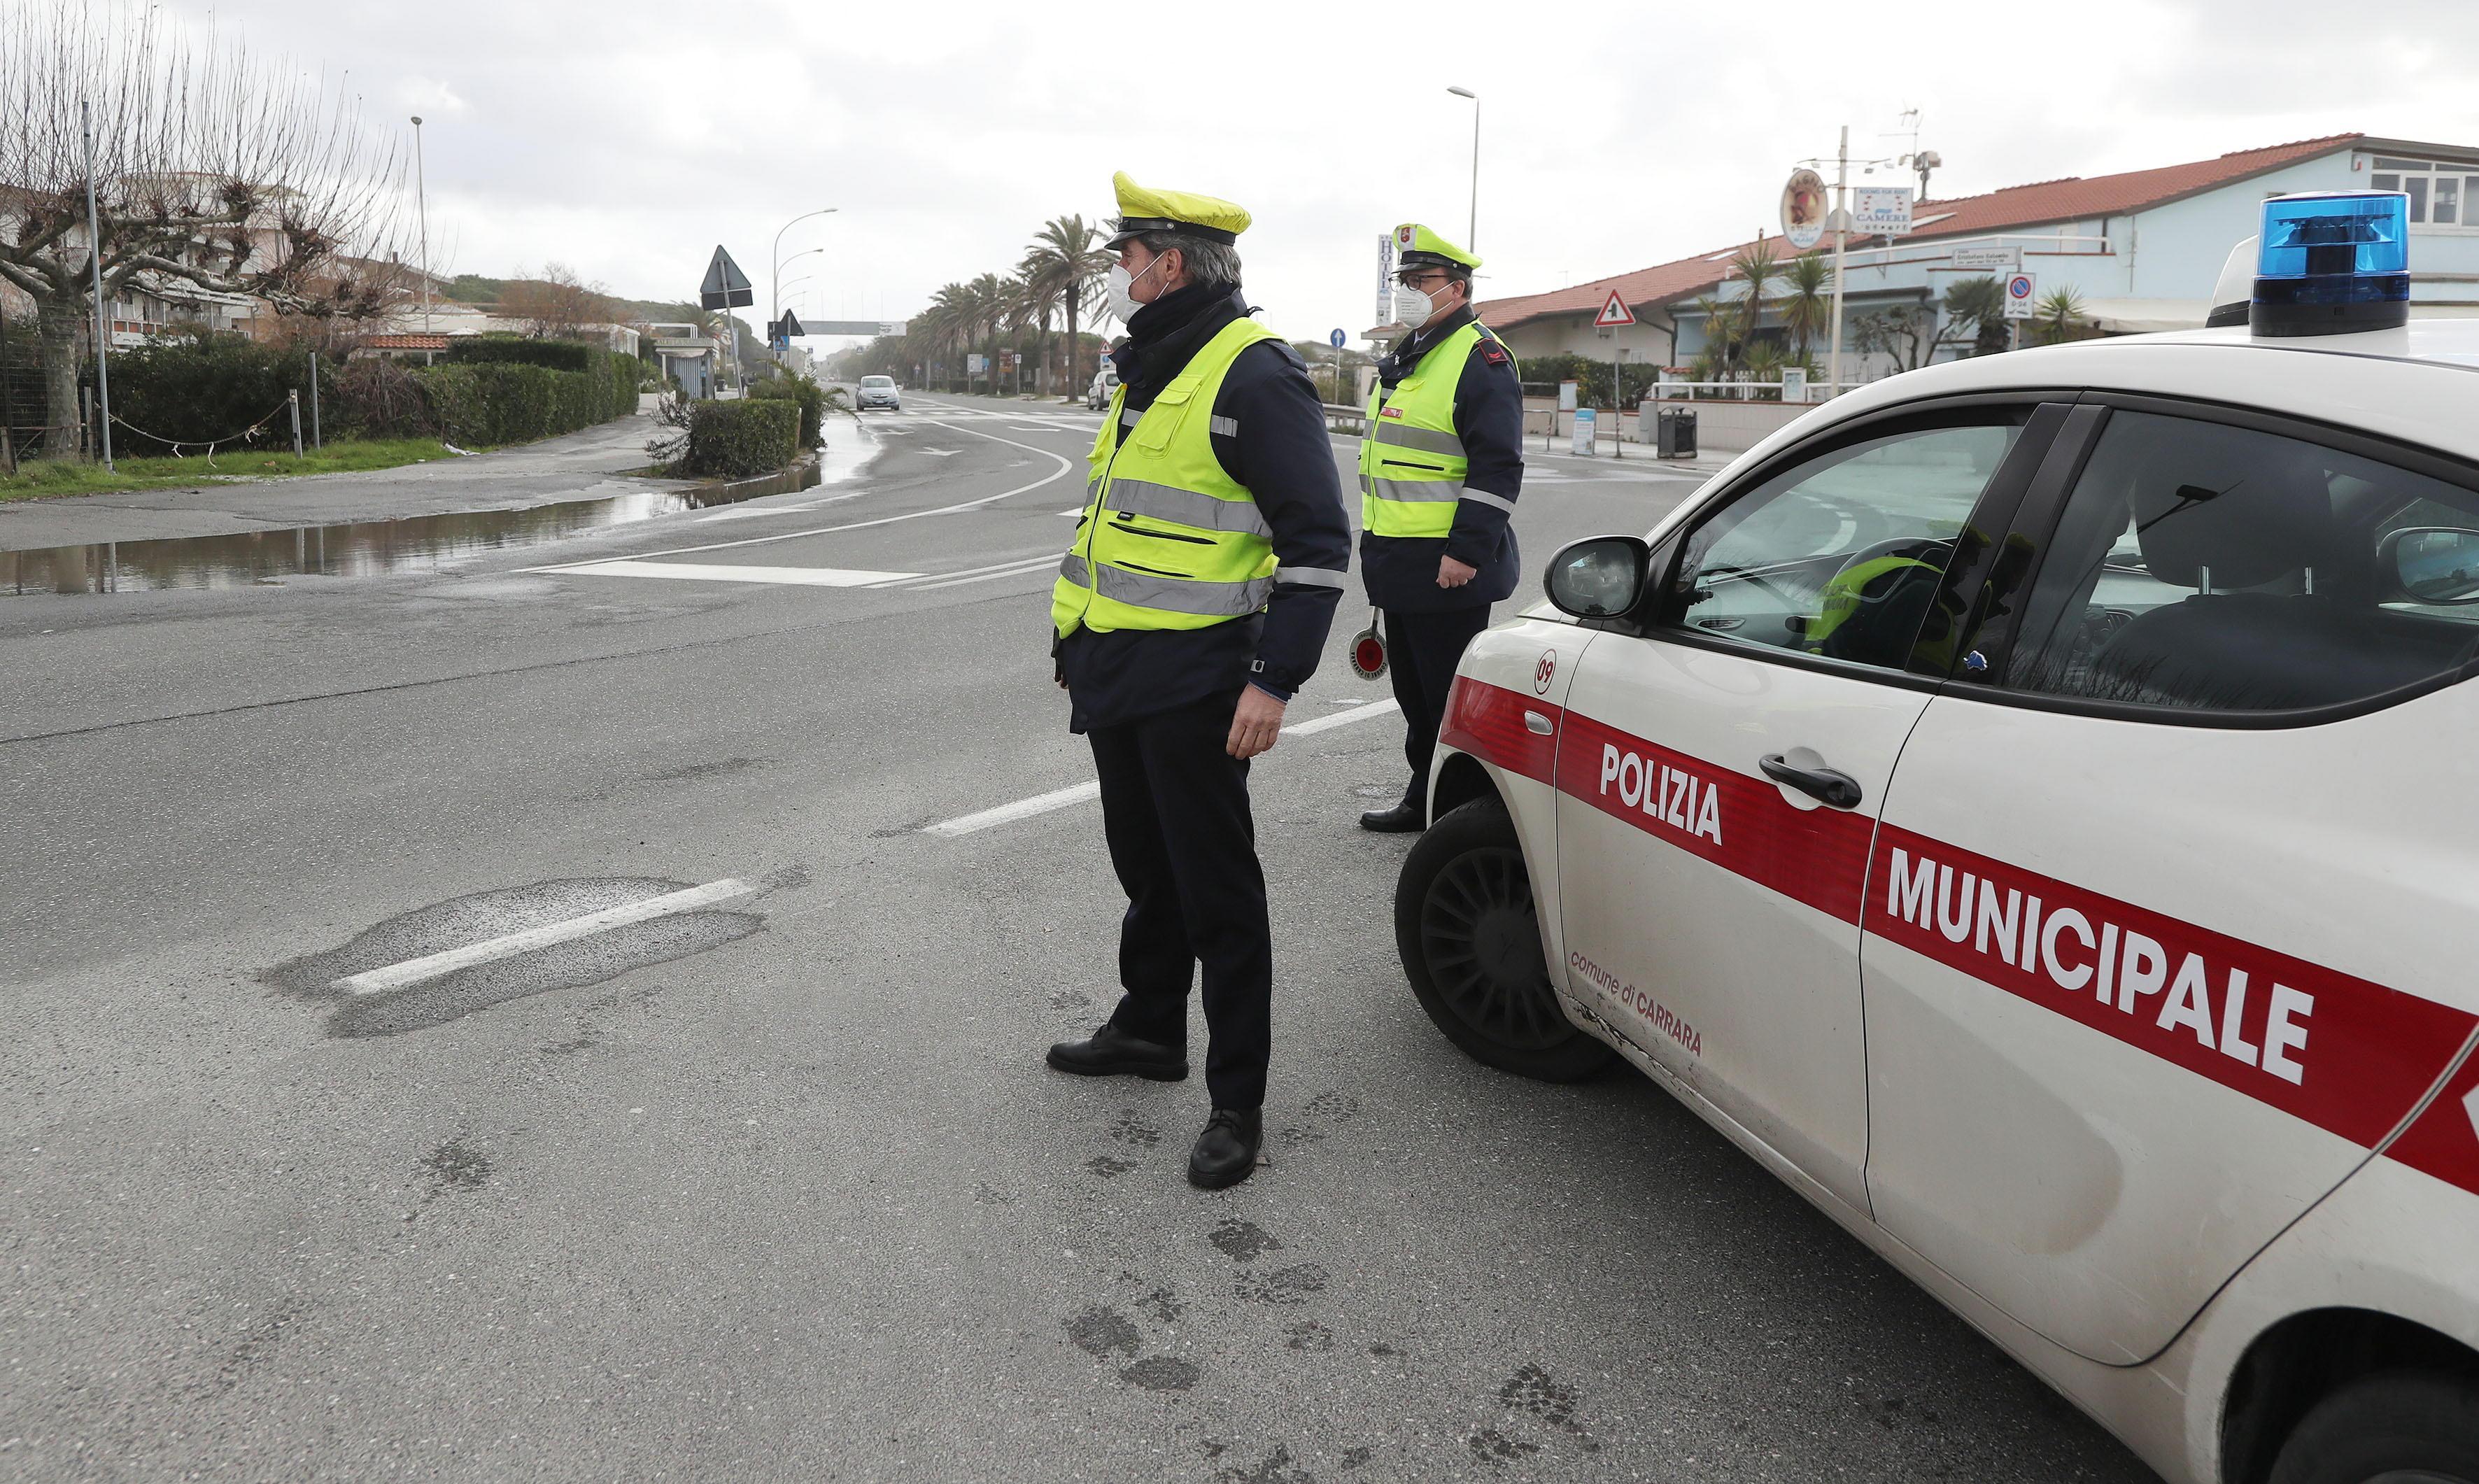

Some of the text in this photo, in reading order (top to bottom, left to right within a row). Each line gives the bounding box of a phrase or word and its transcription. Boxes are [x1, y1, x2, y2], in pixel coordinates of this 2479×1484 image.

[1380, 241, 1392, 289] HOTEL
[1350, 652, 1364, 675] CARRARA
[1537, 659, 1553, 683] 09
[1600, 742, 1723, 846] POLIZIA
[1571, 952, 1702, 1057] comune di CARRARA
[1886, 847, 2315, 1087] MUNICIPALE
